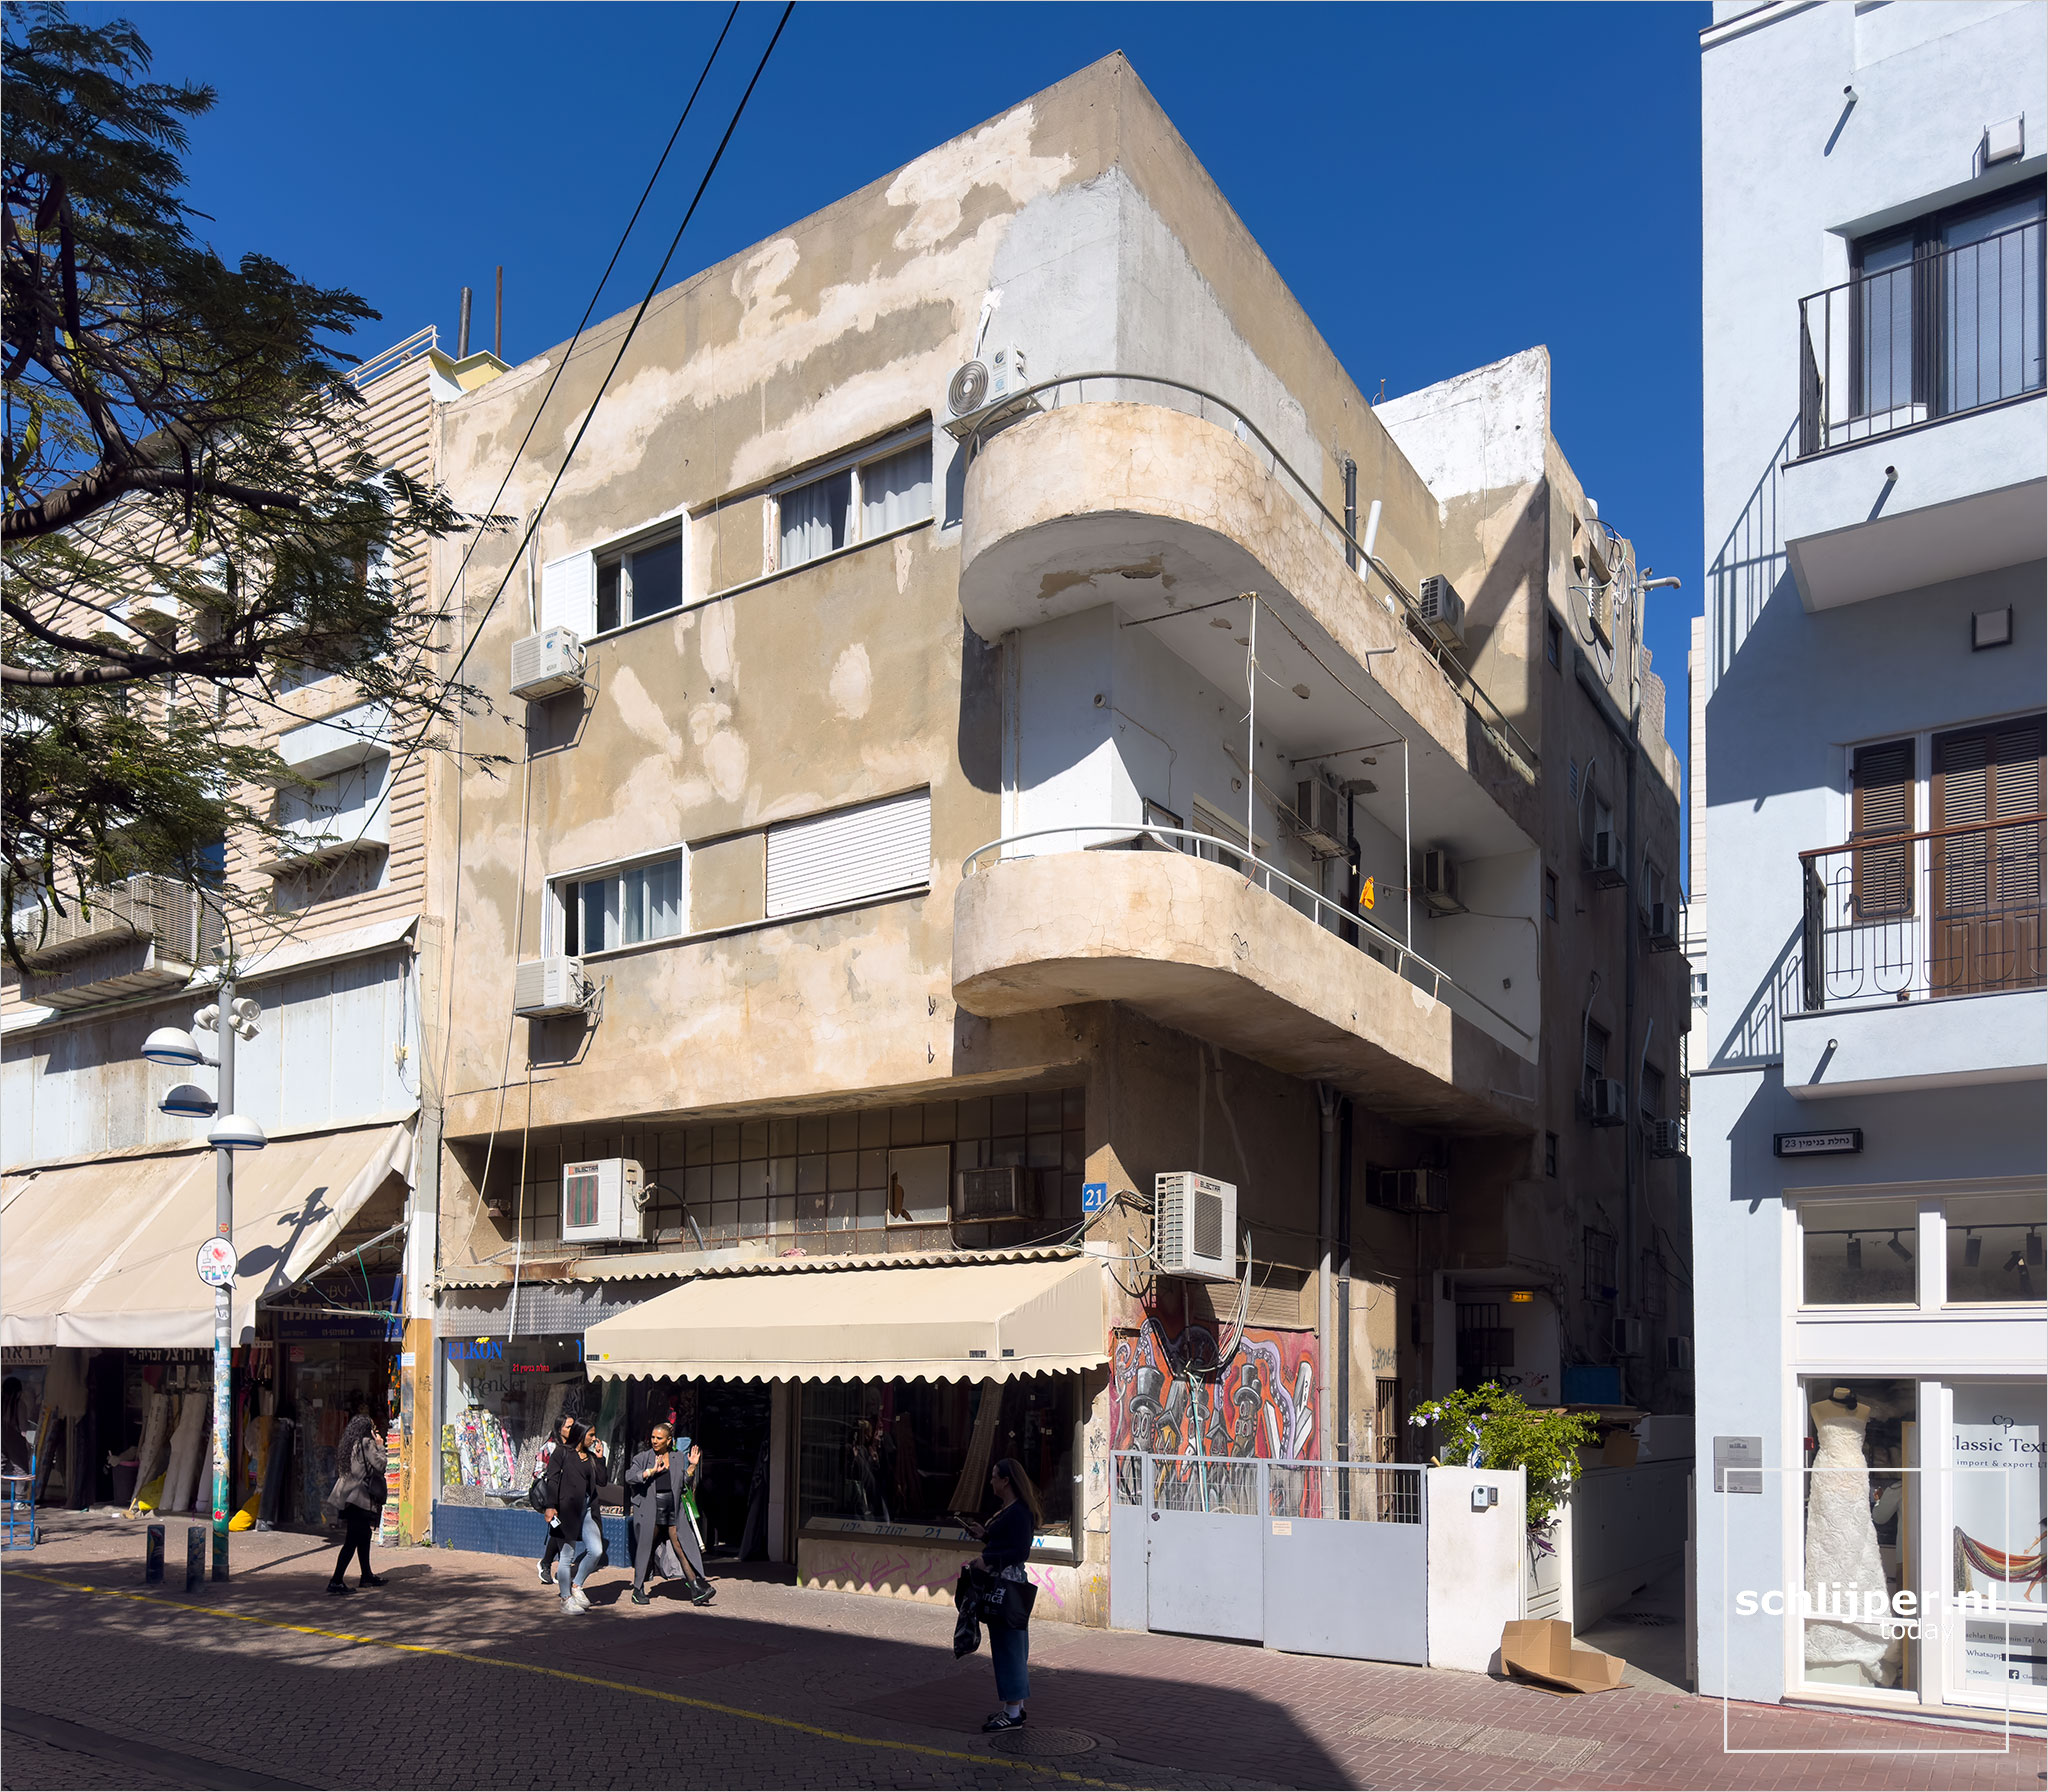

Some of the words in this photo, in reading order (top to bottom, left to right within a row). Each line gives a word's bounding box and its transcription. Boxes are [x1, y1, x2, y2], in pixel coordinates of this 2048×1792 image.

[1784, 1139, 1797, 1149] 23
[1798, 1139, 1825, 1149] בנימין
[1828, 1136, 1850, 1145] נחלת
[1085, 1189, 1103, 1207] 21
[201, 1264, 232, 1281] TLV
[447, 1341, 503, 1360] ELKON
[512, 1363, 520, 1372] 21
[1953, 1434, 2003, 1452] lassic
[1957, 1459, 1988, 1468] import
[2002, 1461, 2034, 1469] export
[922, 1527, 943, 1539] 21
[1988, 1633, 2022, 1643] Binymin
[2024, 1636, 2035, 1644] Tel
